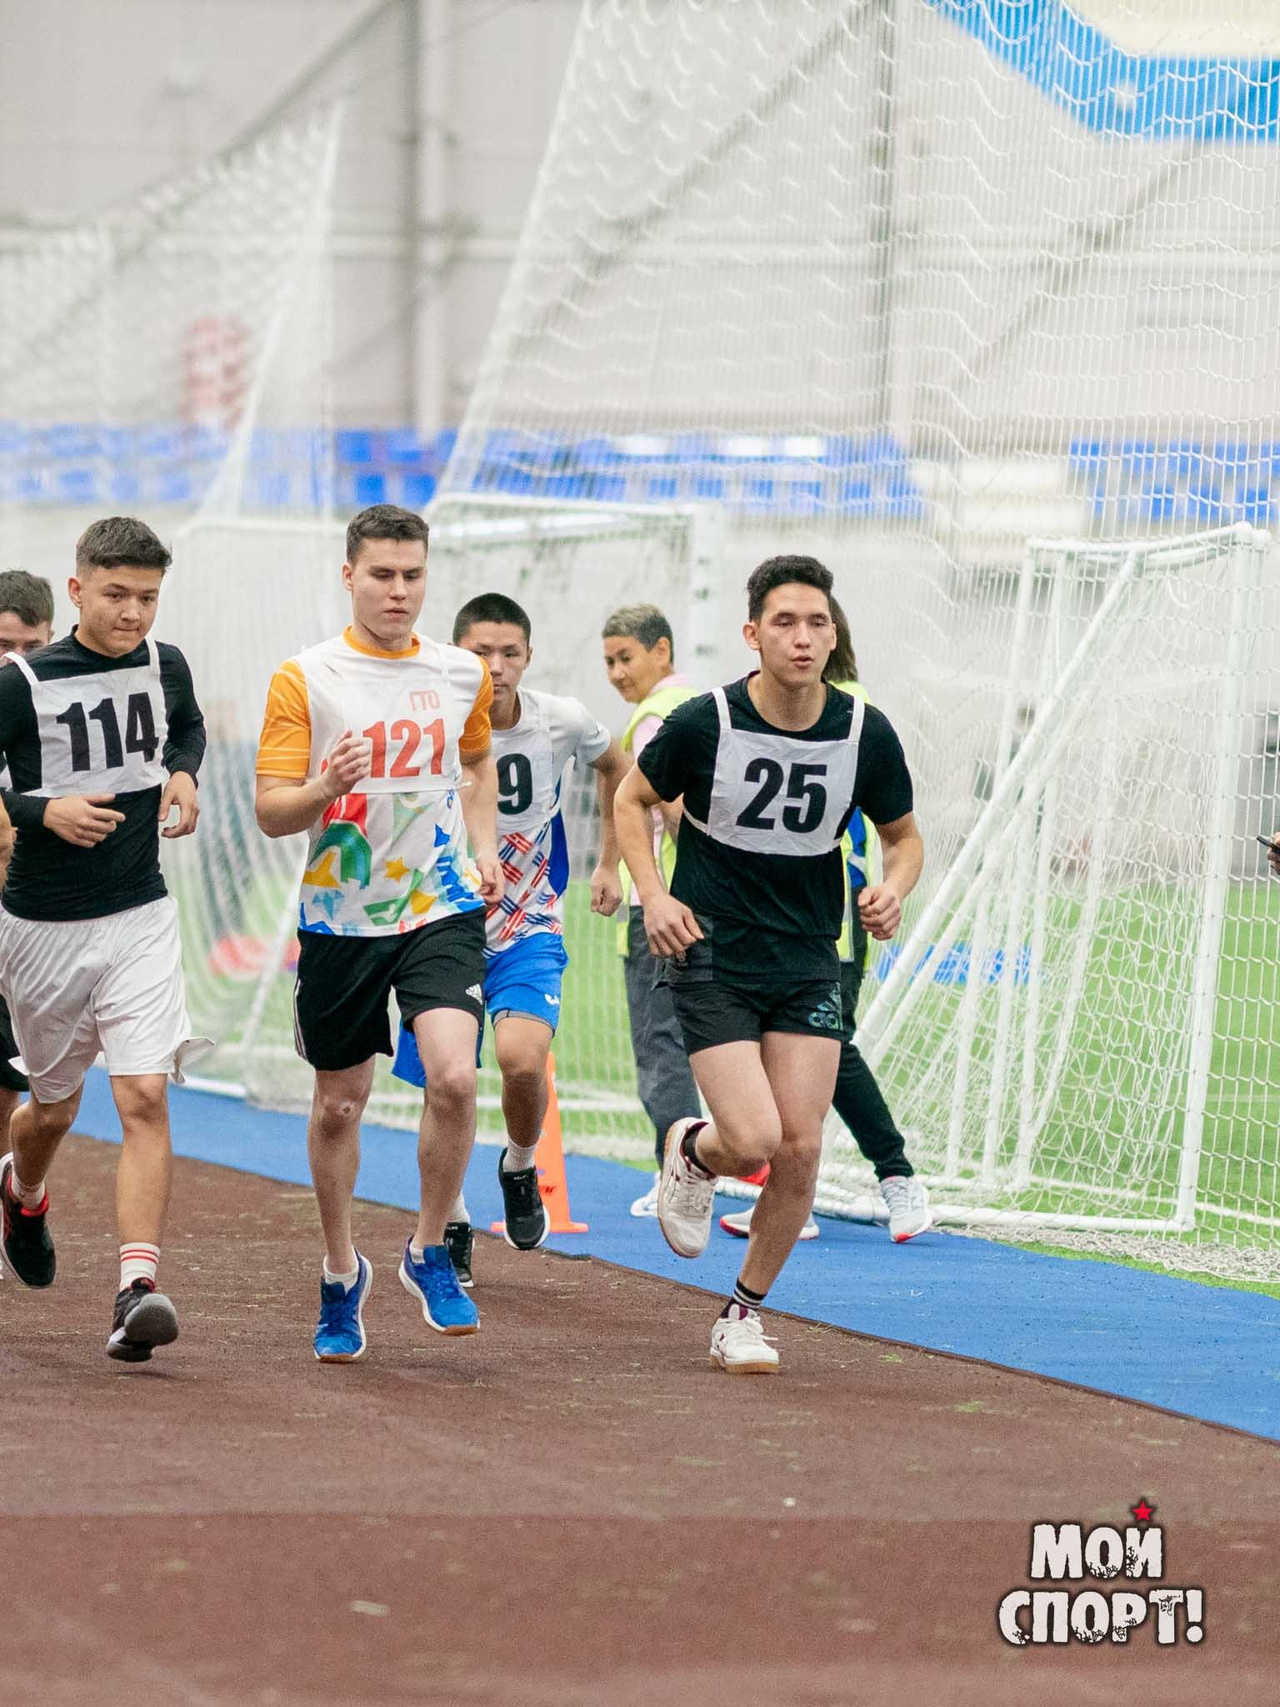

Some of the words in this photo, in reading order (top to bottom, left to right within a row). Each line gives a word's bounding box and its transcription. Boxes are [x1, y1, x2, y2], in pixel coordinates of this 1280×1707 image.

[55, 692, 159, 772] 114
[362, 718, 446, 778] 121
[736, 757, 827, 834] 25
